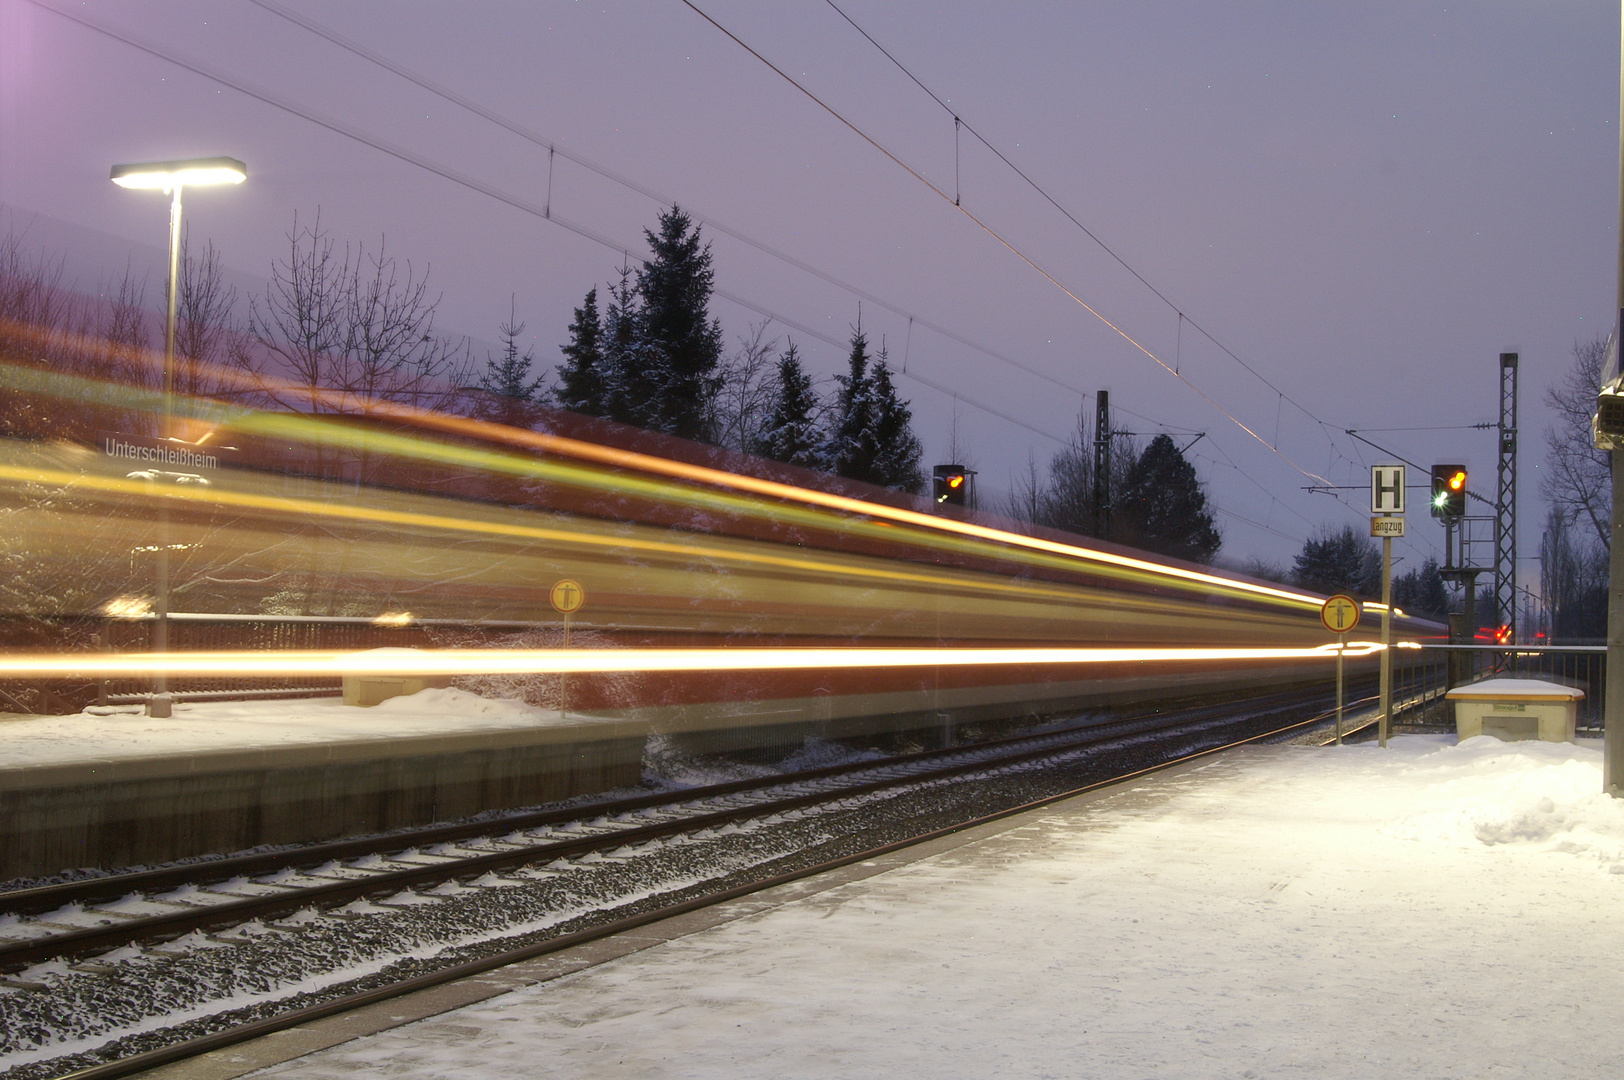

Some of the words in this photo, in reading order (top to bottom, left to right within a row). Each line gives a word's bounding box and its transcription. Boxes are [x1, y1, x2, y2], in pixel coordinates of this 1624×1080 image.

[105, 437, 217, 469] Unterschleißheim
[1375, 470, 1401, 509] H
[1372, 521, 1402, 534] Langzug
